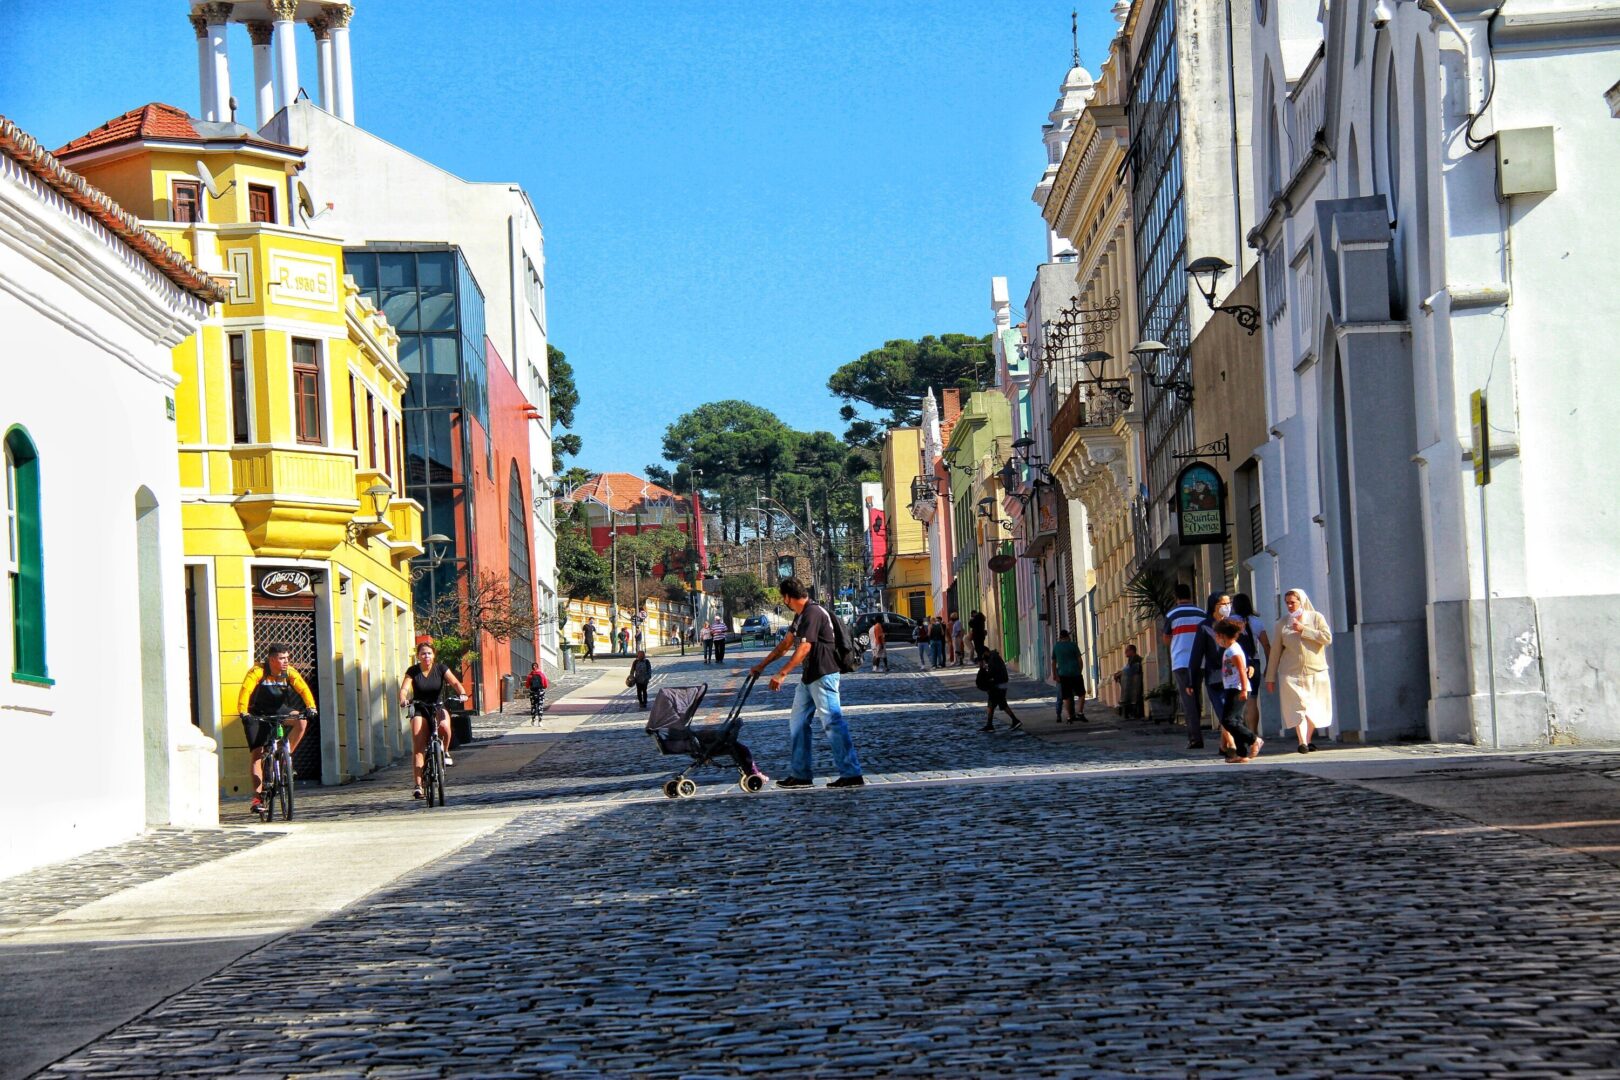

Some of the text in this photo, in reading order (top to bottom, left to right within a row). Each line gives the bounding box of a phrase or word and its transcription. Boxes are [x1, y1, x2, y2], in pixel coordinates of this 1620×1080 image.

[1183, 511, 1219, 523] Quintal
[1189, 523, 1219, 534] Monge
[264, 572, 307, 590] LARGO'S BAR
